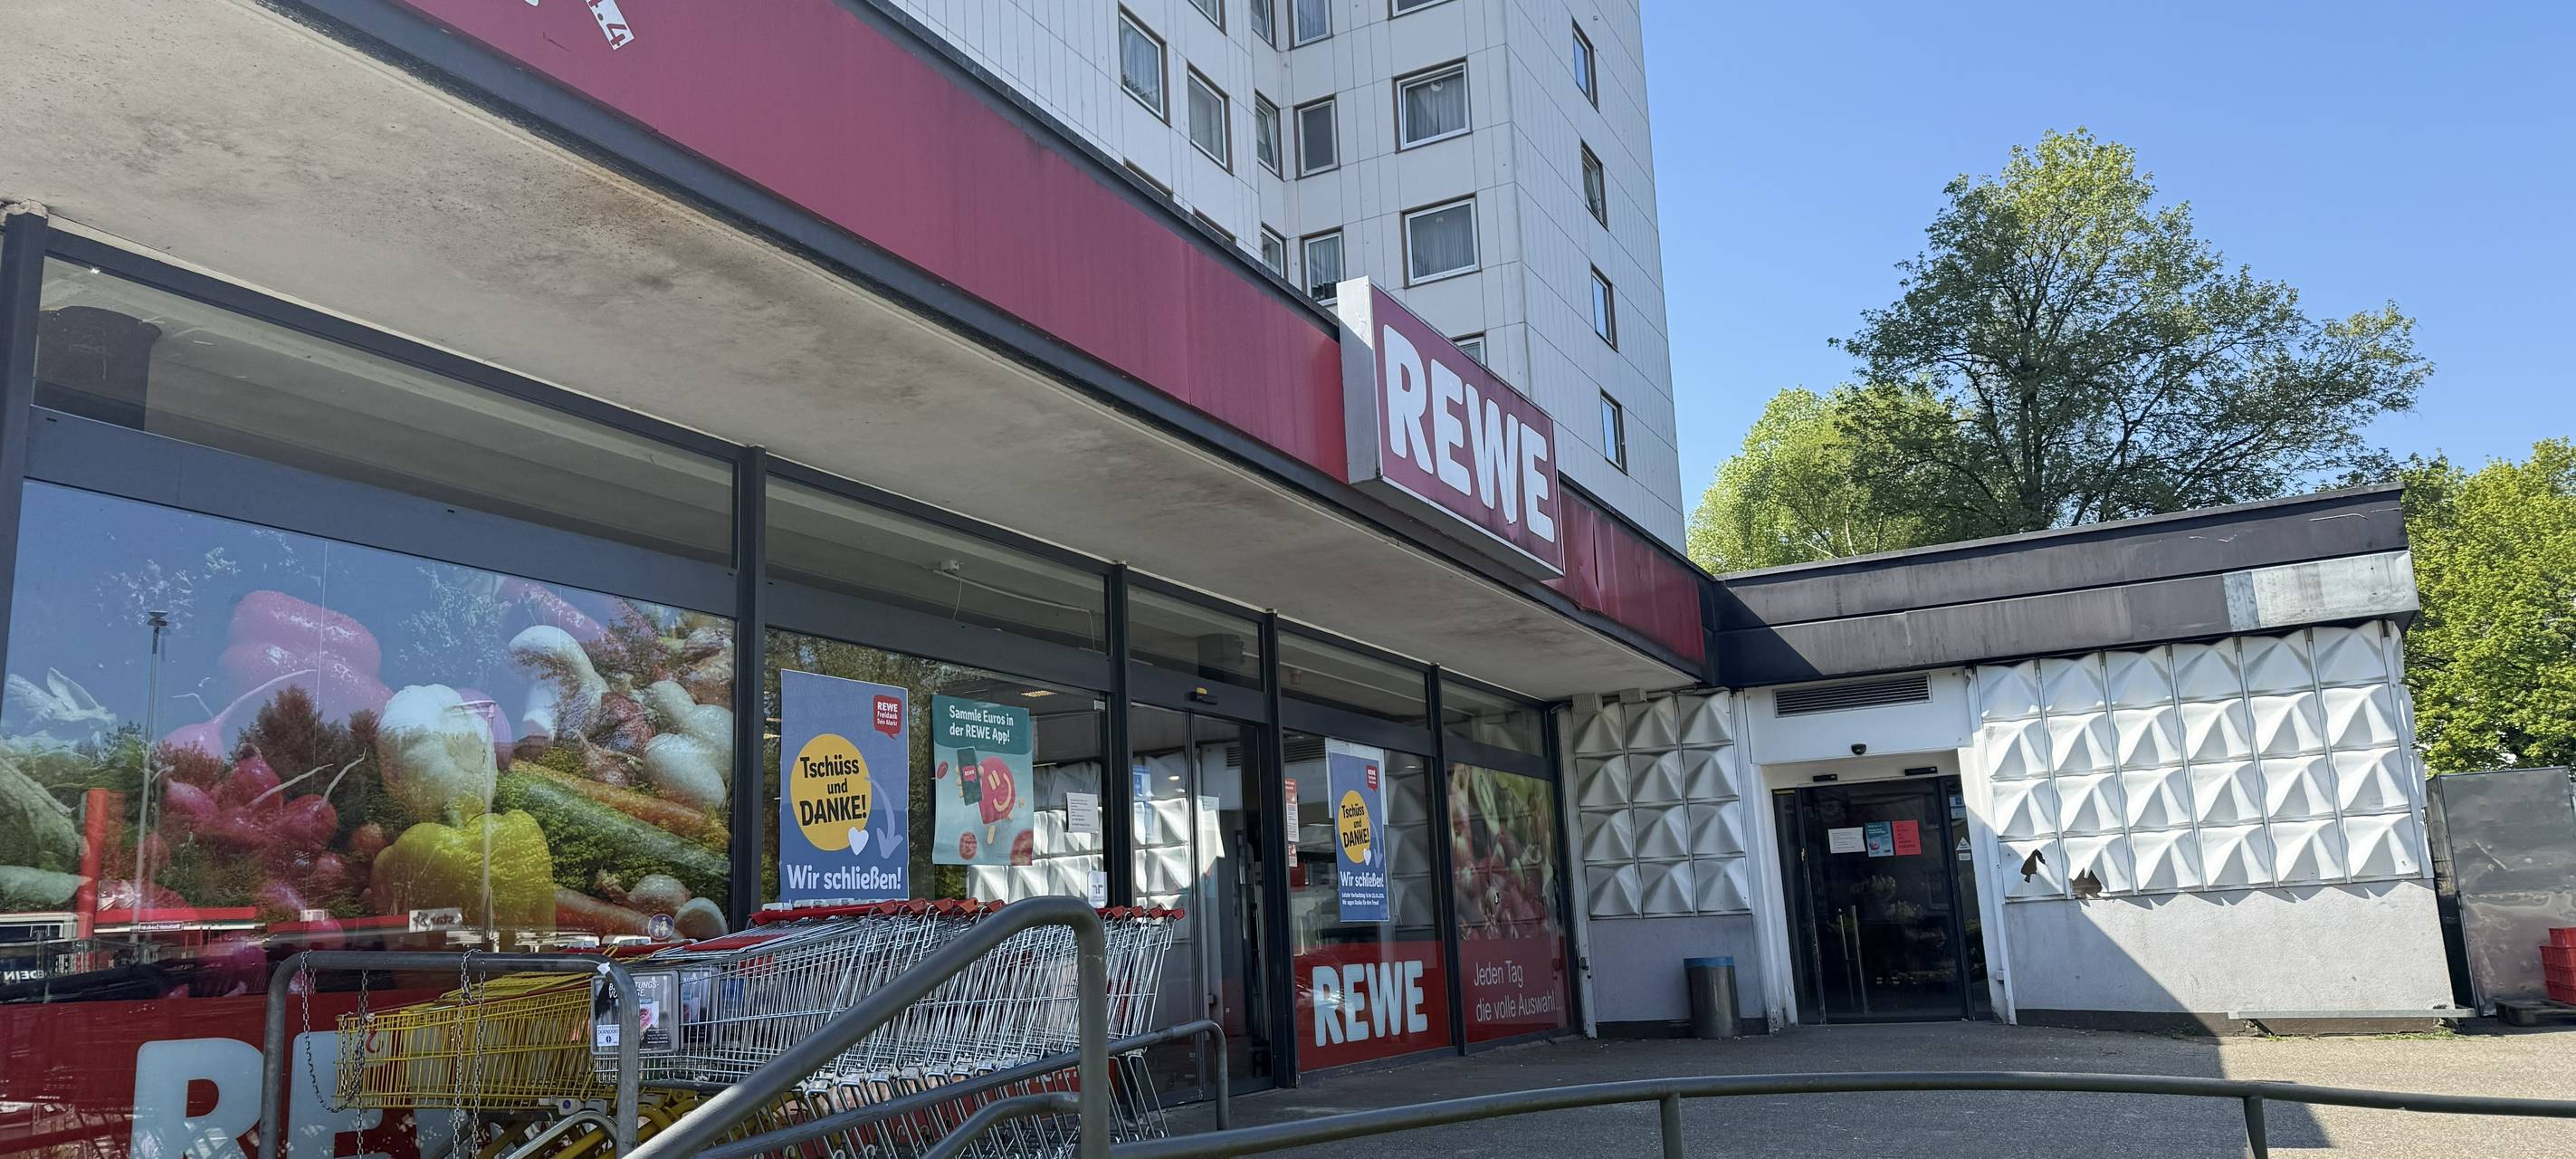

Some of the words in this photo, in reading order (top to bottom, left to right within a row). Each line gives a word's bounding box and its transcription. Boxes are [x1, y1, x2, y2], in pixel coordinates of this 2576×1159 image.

[1383, 324, 1555, 542] REWE
[877, 702, 899, 713] REWE
[949, 705, 982, 722] Sammle
[983, 710, 1005, 725] Euros
[1007, 714, 1014, 726] in
[949, 723, 964, 736] der
[966, 724, 991, 740] REWE
[992, 727, 1010, 744] App!
[800, 754, 860, 779] Tschüss
[827, 778, 848, 795] und
[799, 794, 867, 826] DANKE!
[1341, 803, 1365, 819] Tschüss
[1353, 818, 1361, 829] und
[1342, 829, 1369, 848] DANKE!
[787, 864, 820, 889] Wir
[824, 866, 902, 890] schließen!
[1340, 870, 1354, 887] Wir
[1354, 872, 1384, 888] schließen!
[1474, 962, 1503, 987] Jeden
[1505, 960, 1523, 988] Tag
[1312, 960, 1428, 1047] REWE
[1476, 1001, 1492, 1022] die
[1493, 994, 1517, 1018] volle
